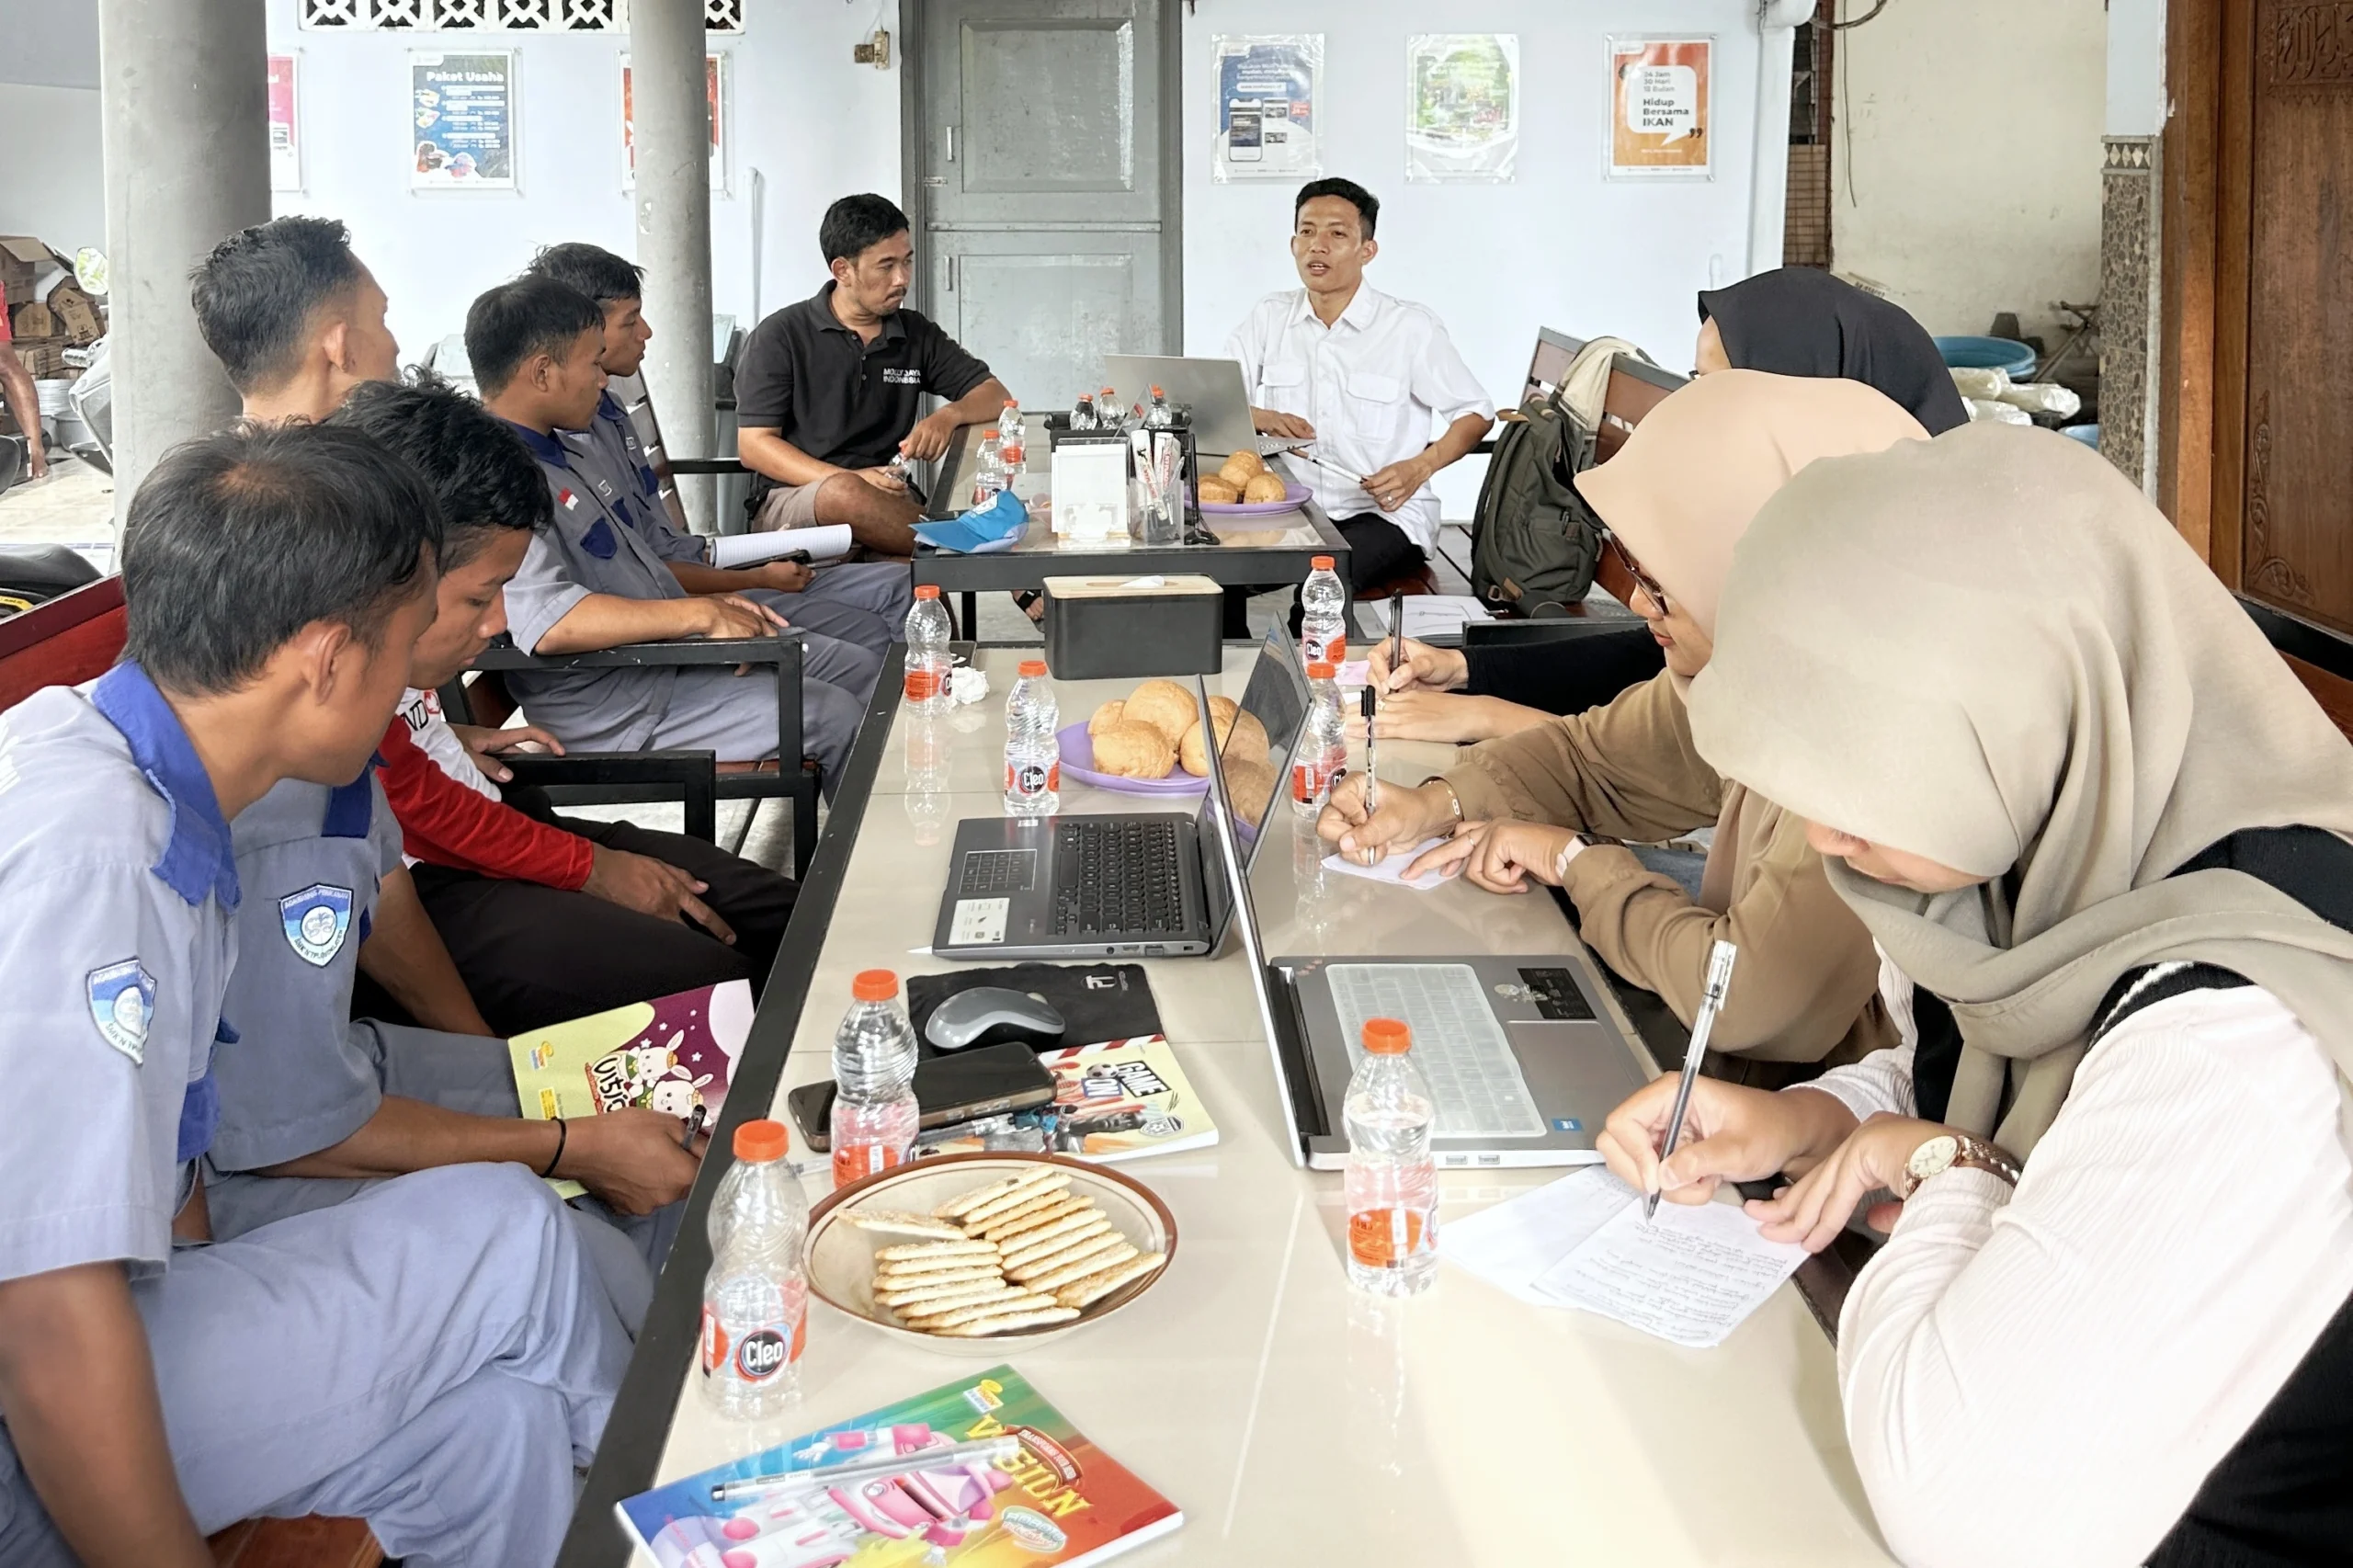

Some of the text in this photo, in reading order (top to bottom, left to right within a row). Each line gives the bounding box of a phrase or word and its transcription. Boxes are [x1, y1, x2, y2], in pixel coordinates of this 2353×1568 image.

[426, 71, 505, 82] Paket Usaha
[1643, 98, 1675, 108] Hidup
[1643, 108, 1689, 116] Bersama
[1643, 118, 1674, 127] IKAN
[1306, 642, 1322, 656] Cleo
[1023, 771, 1044, 787] Cleo
[1118, 1062, 1169, 1097] GAME
[1084, 1078, 1120, 1096] ON
[745, 1340, 784, 1367] Cleo
